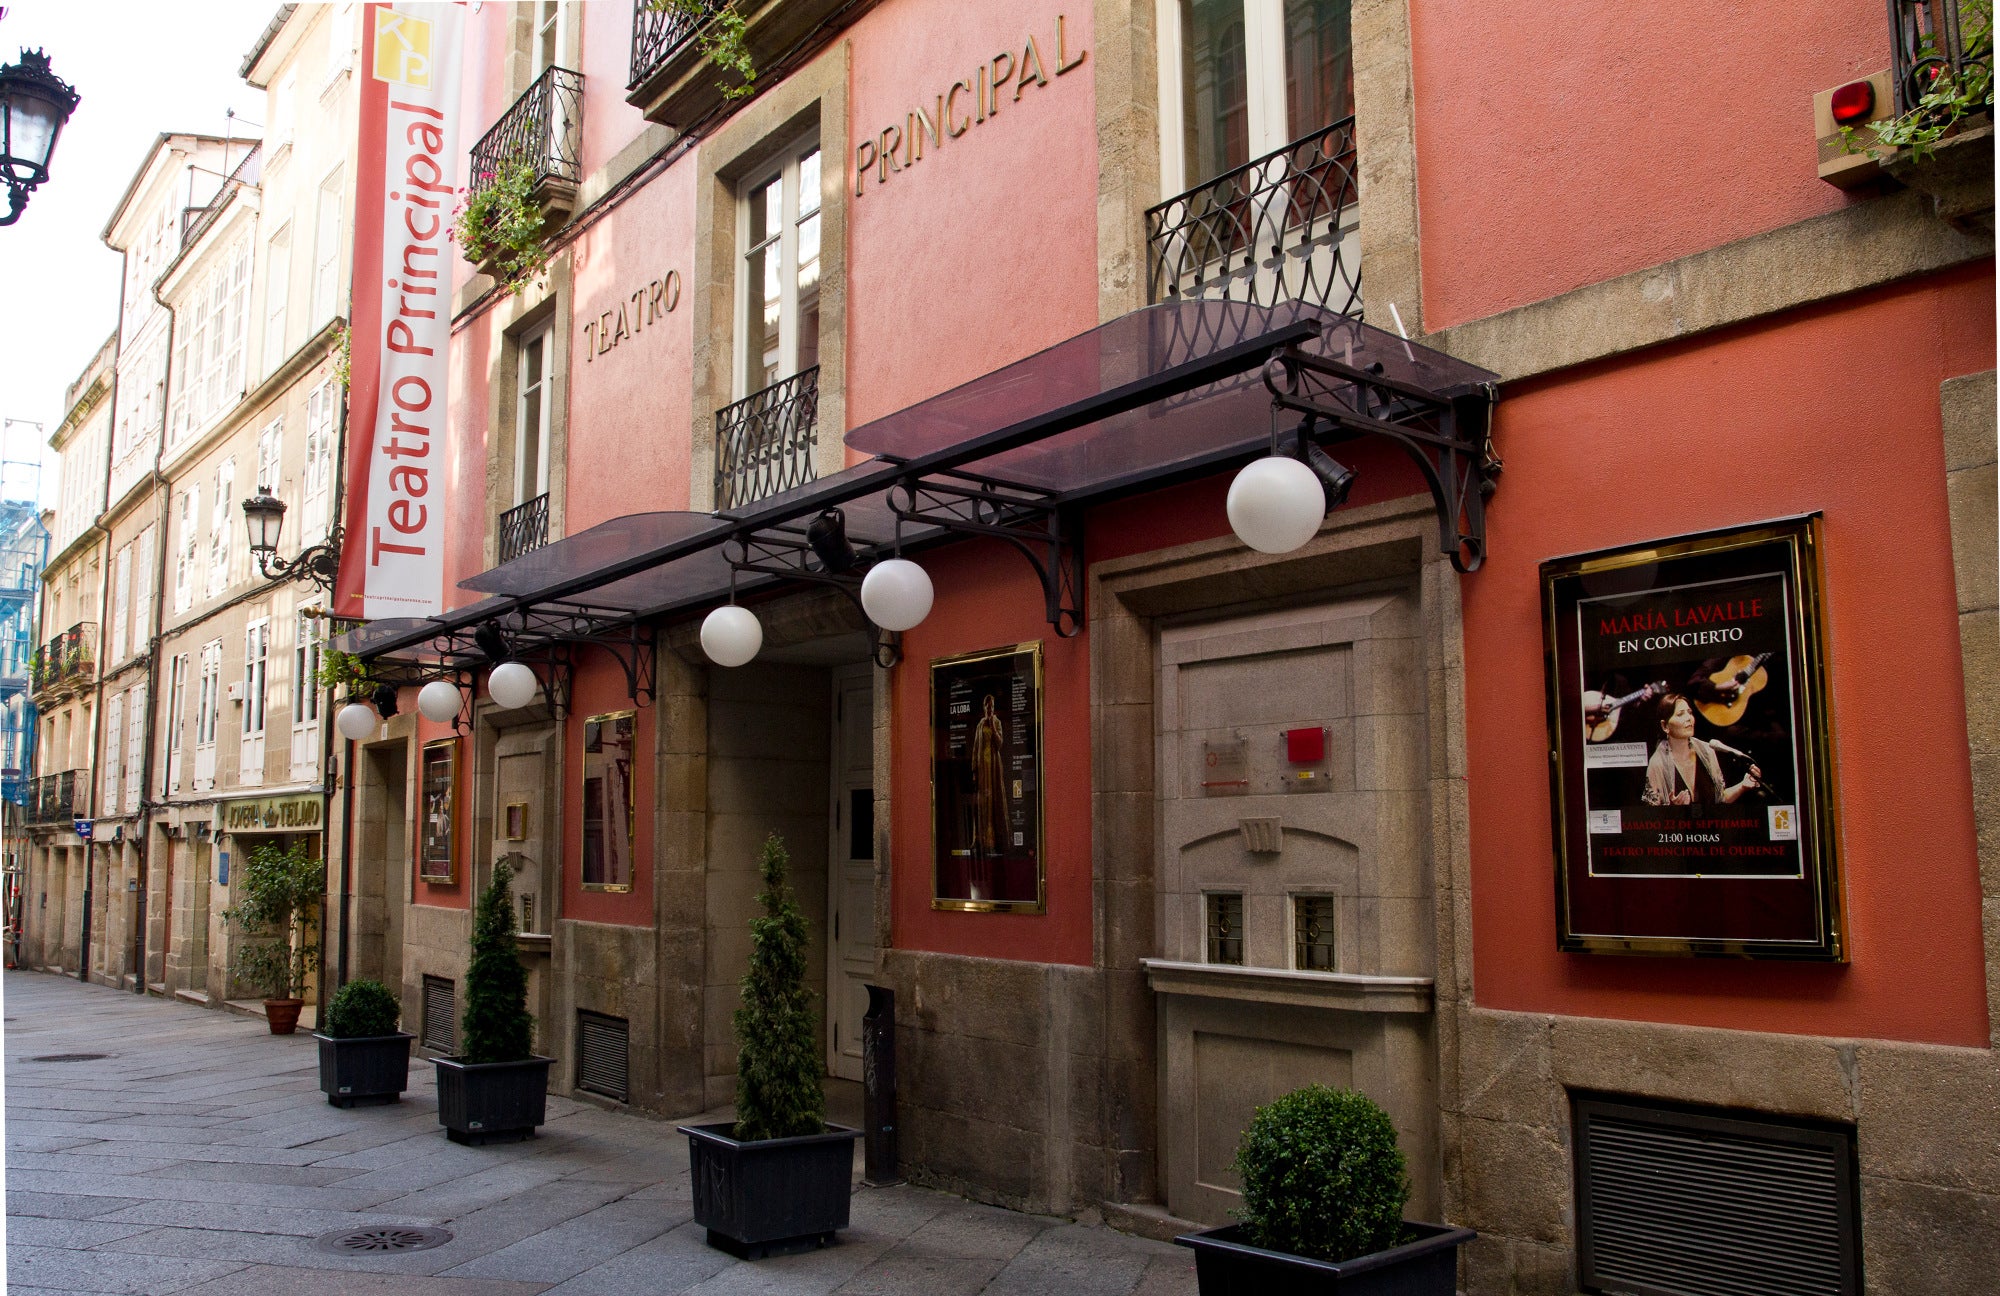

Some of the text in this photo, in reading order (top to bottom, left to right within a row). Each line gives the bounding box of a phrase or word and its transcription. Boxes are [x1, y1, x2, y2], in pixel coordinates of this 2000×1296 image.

[583, 15, 1086, 362] TEATRO PRINCIPAL
[371, 101, 454, 566] Teatro Principal
[1599, 598, 1763, 636] MARÍA LAVALLE
[1618, 627, 1744, 654] EN CONCIERTO
[1658, 833, 1720, 843] 21:00 HORAS
[1678, 820, 1691, 830] DE
[1695, 819, 1760, 829] SEPTIEMBRE
[1602, 846, 1786, 857] TEATRO PRINCIPAL DE OURENSE
